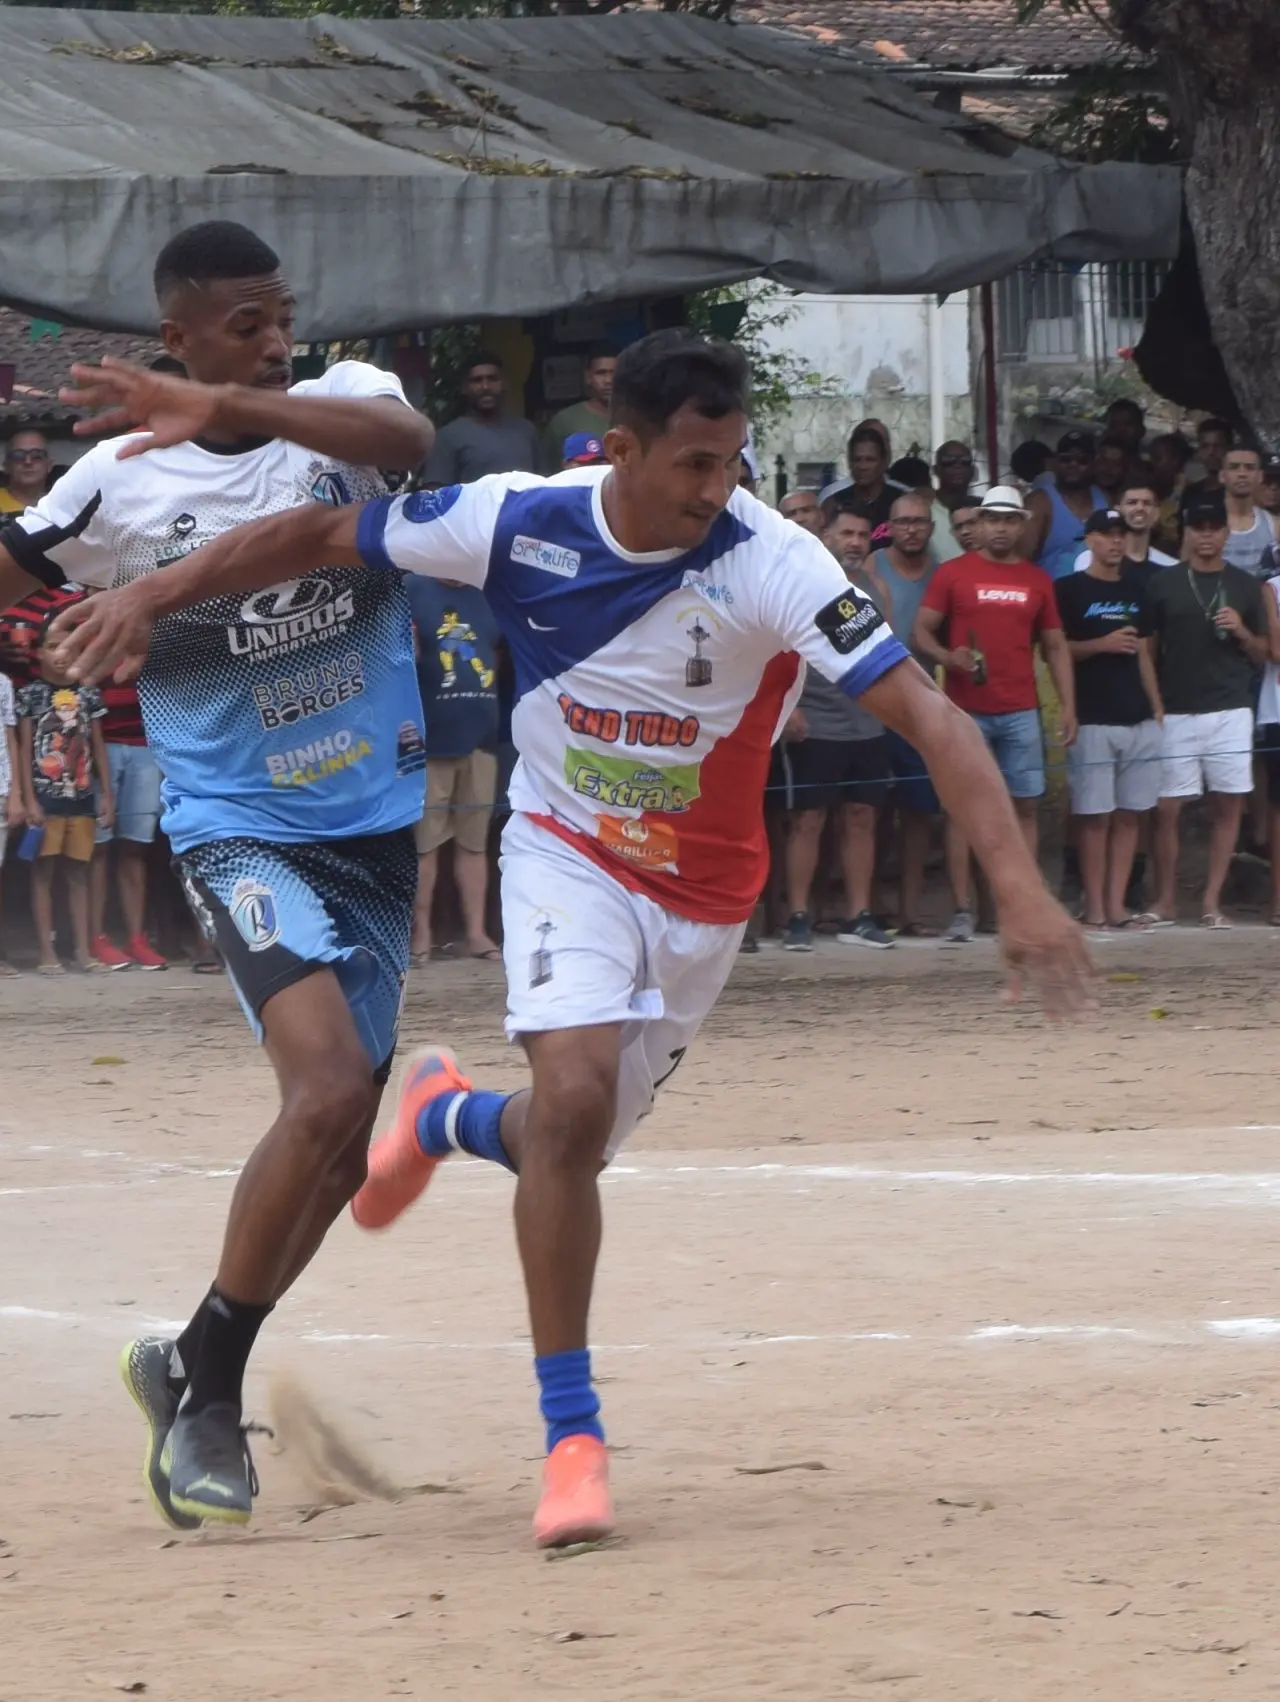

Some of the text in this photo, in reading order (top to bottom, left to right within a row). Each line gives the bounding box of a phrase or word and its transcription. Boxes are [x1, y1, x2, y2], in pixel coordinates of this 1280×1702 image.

[227, 588, 355, 656] UNIDOS
[253, 653, 362, 706] BRUNO
[624, 711, 700, 746] TUDO
[266, 729, 352, 776] BINHO
[574, 766, 666, 810] Extra
